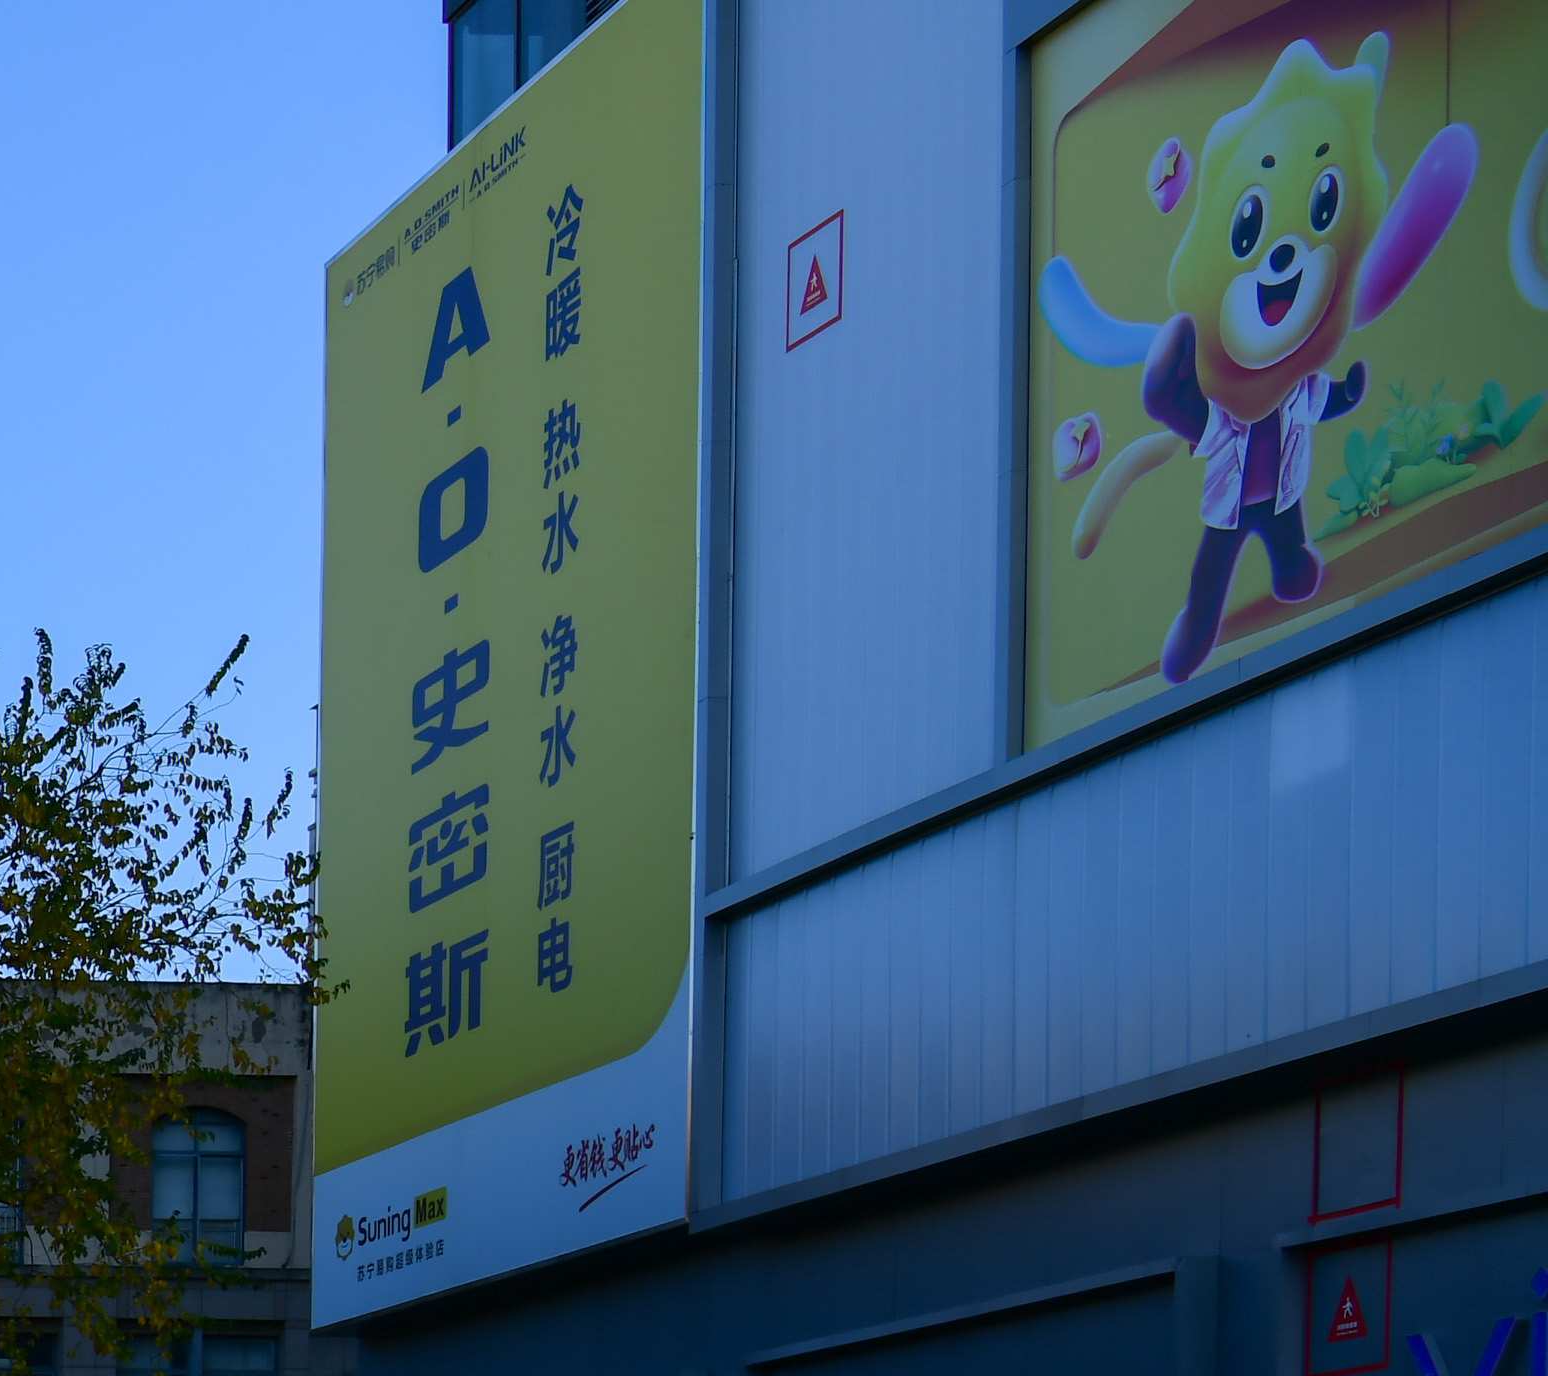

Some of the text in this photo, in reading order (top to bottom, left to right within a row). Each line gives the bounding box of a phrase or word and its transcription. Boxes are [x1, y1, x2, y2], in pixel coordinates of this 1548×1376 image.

[535, 184, 585, 994] 冷暖 热水 净水 厨电
[358, 1194, 445, 1246] Suning Max
